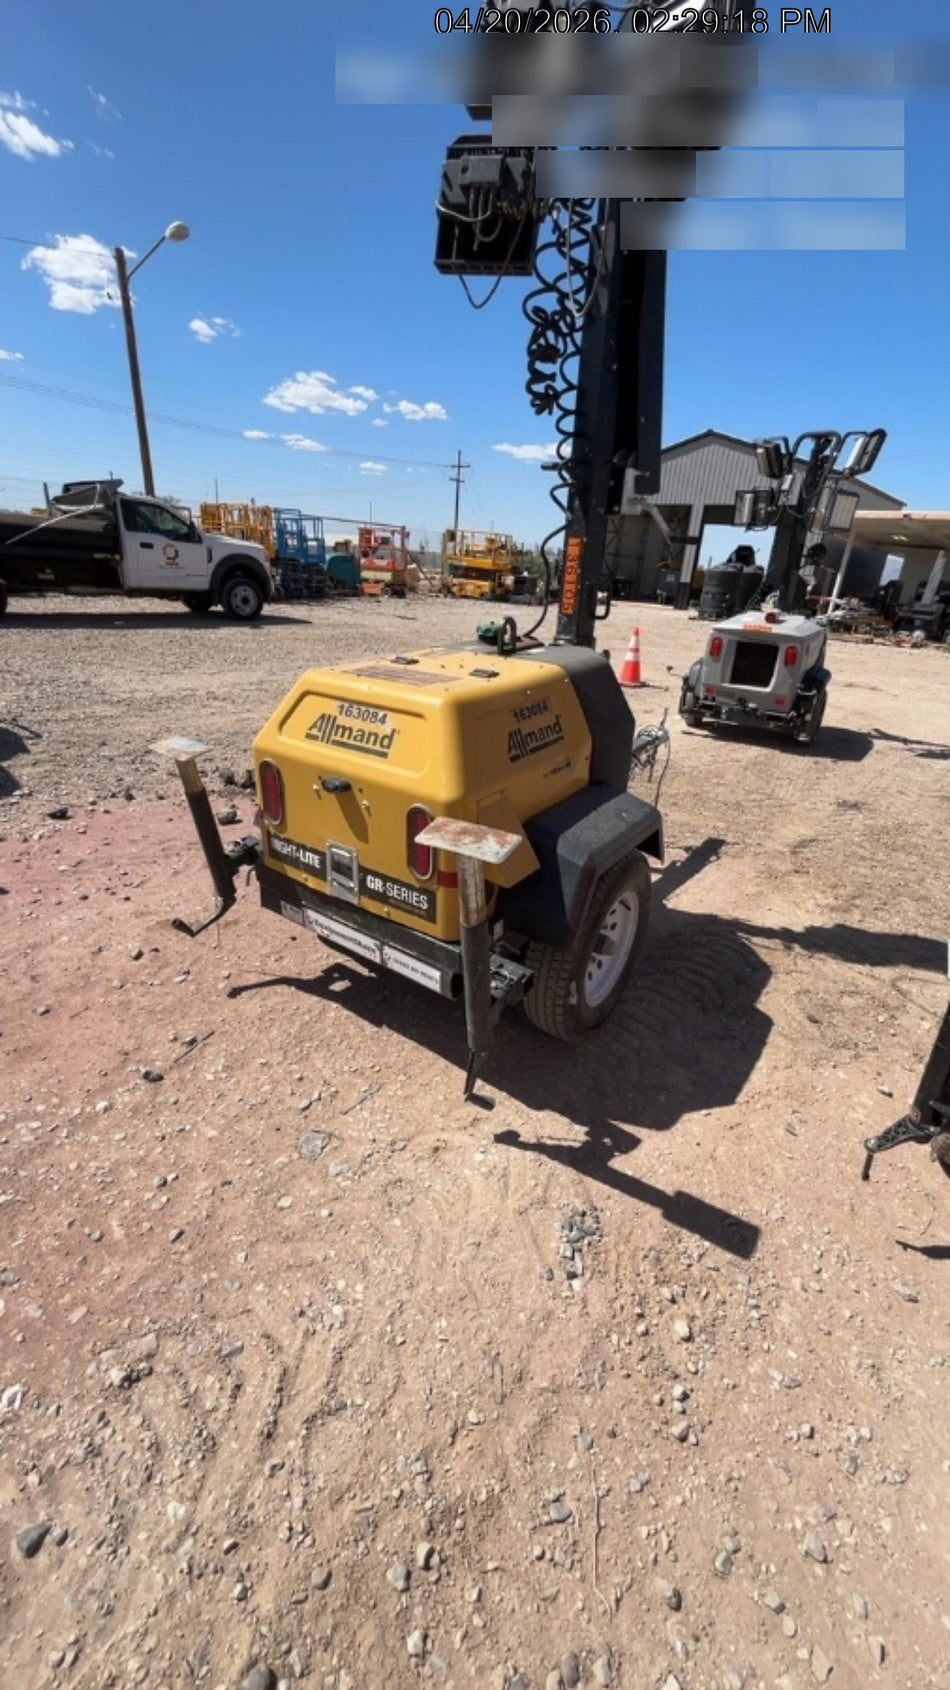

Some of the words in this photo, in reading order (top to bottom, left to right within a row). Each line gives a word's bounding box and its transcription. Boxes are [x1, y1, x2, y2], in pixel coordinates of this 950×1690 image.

[307, 712, 397, 751] Allmand
[338, 703, 388, 726] 163084
[508, 712, 563, 759] Allmand
[272, 837, 321, 869] GHT-LITE
